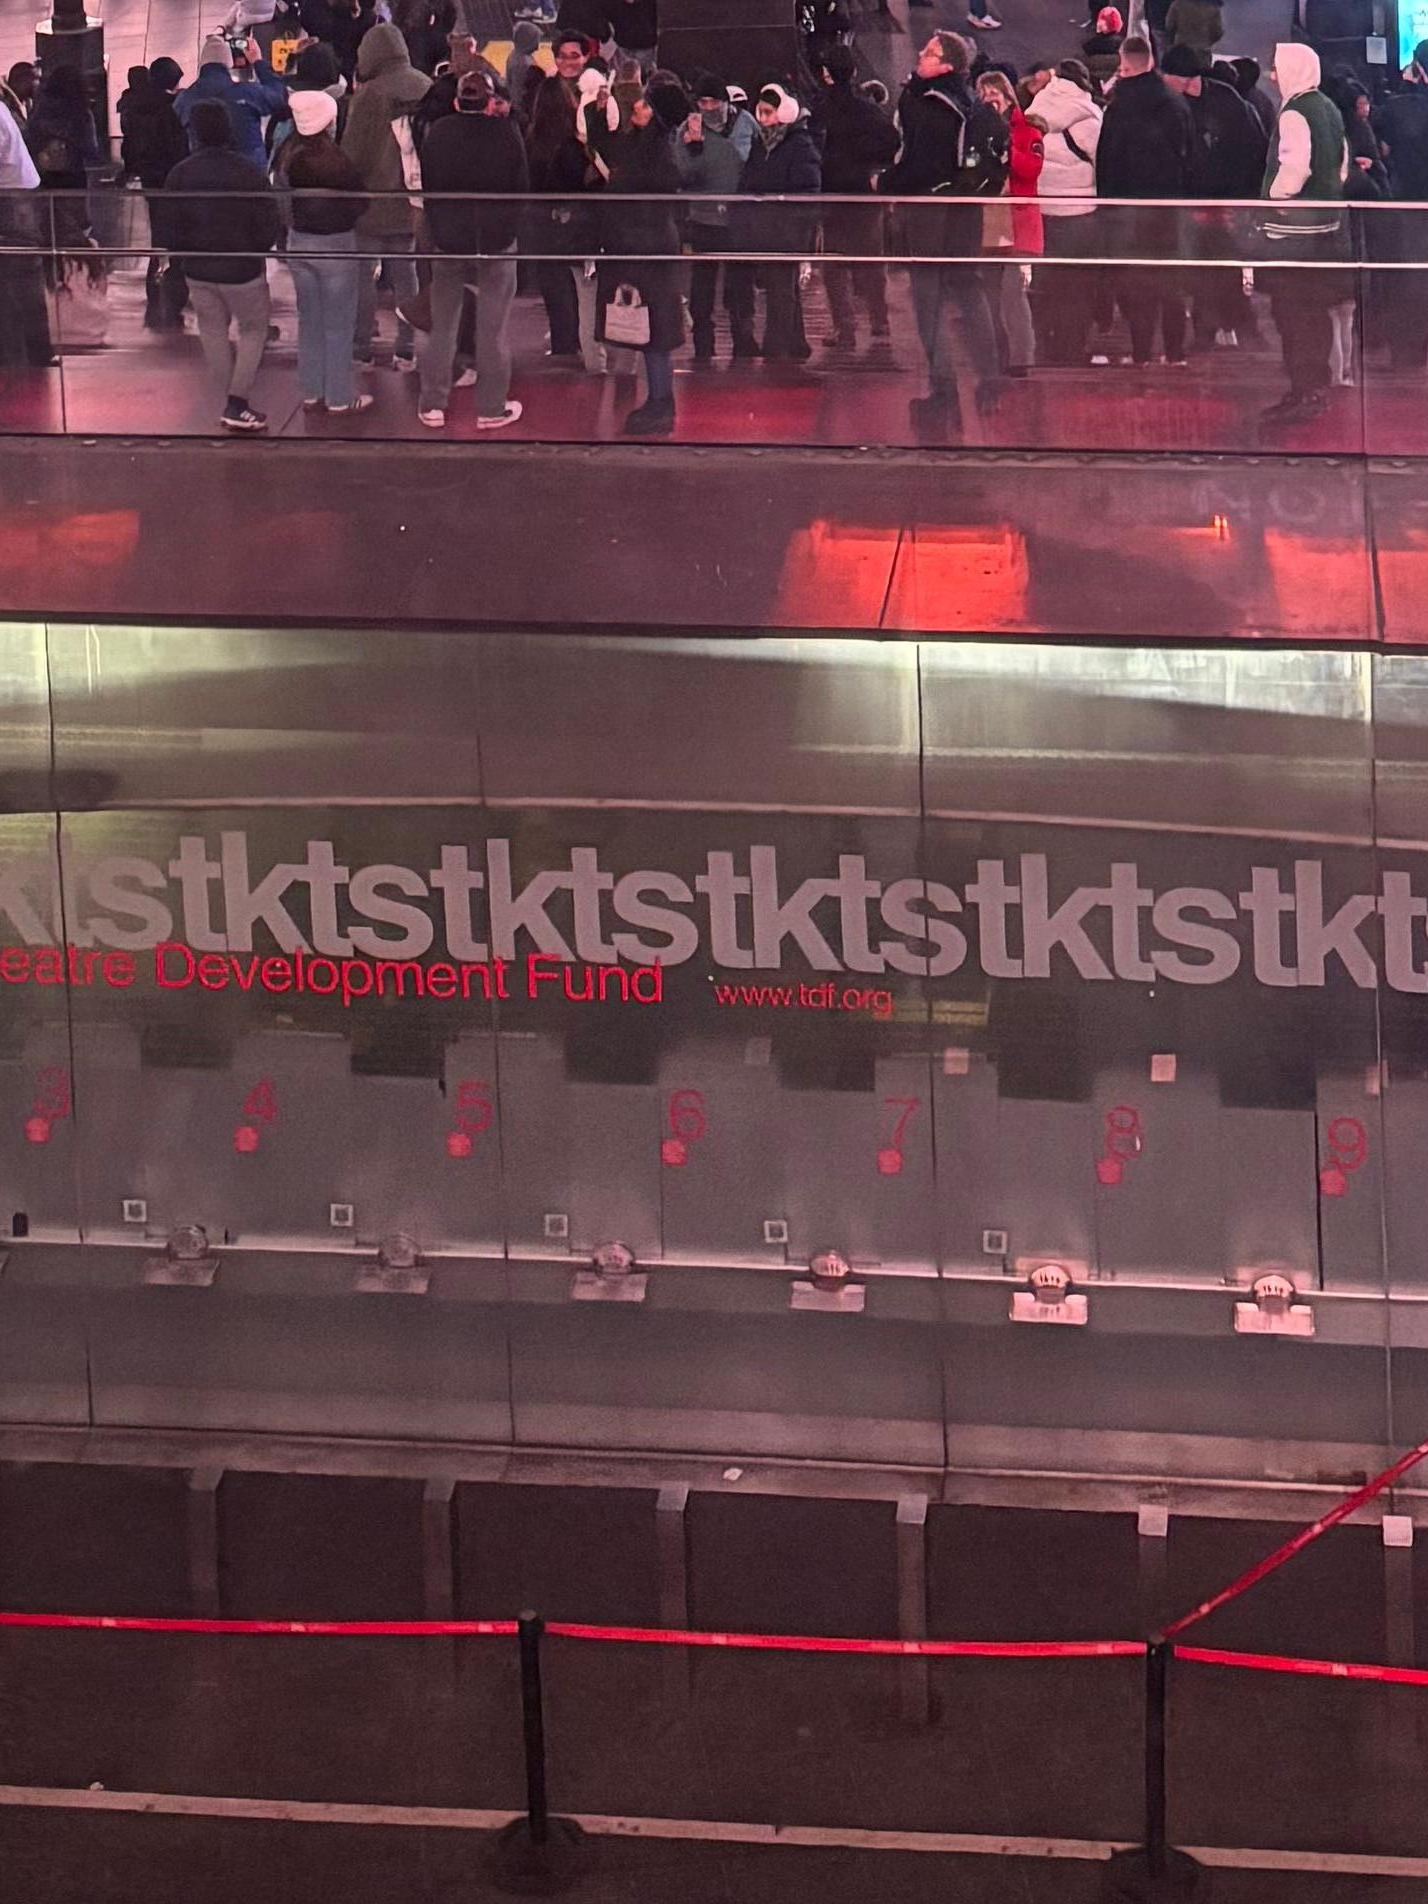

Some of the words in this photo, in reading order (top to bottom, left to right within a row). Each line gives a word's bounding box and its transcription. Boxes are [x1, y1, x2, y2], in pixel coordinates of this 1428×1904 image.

[156, 941, 510, 1004] Development
[528, 953, 665, 1004] Fund
[715, 978, 892, 1015] www.tdf.org
[34, 1065, 72, 1119] 3
[241, 1077, 279, 1125] 4
[455, 1082, 493, 1132] 5
[667, 1089, 705, 1144] 6
[884, 1098, 921, 1147] 7
[1106, 1106, 1143, 1162] 8
[1327, 1115, 1367, 1171] 9
